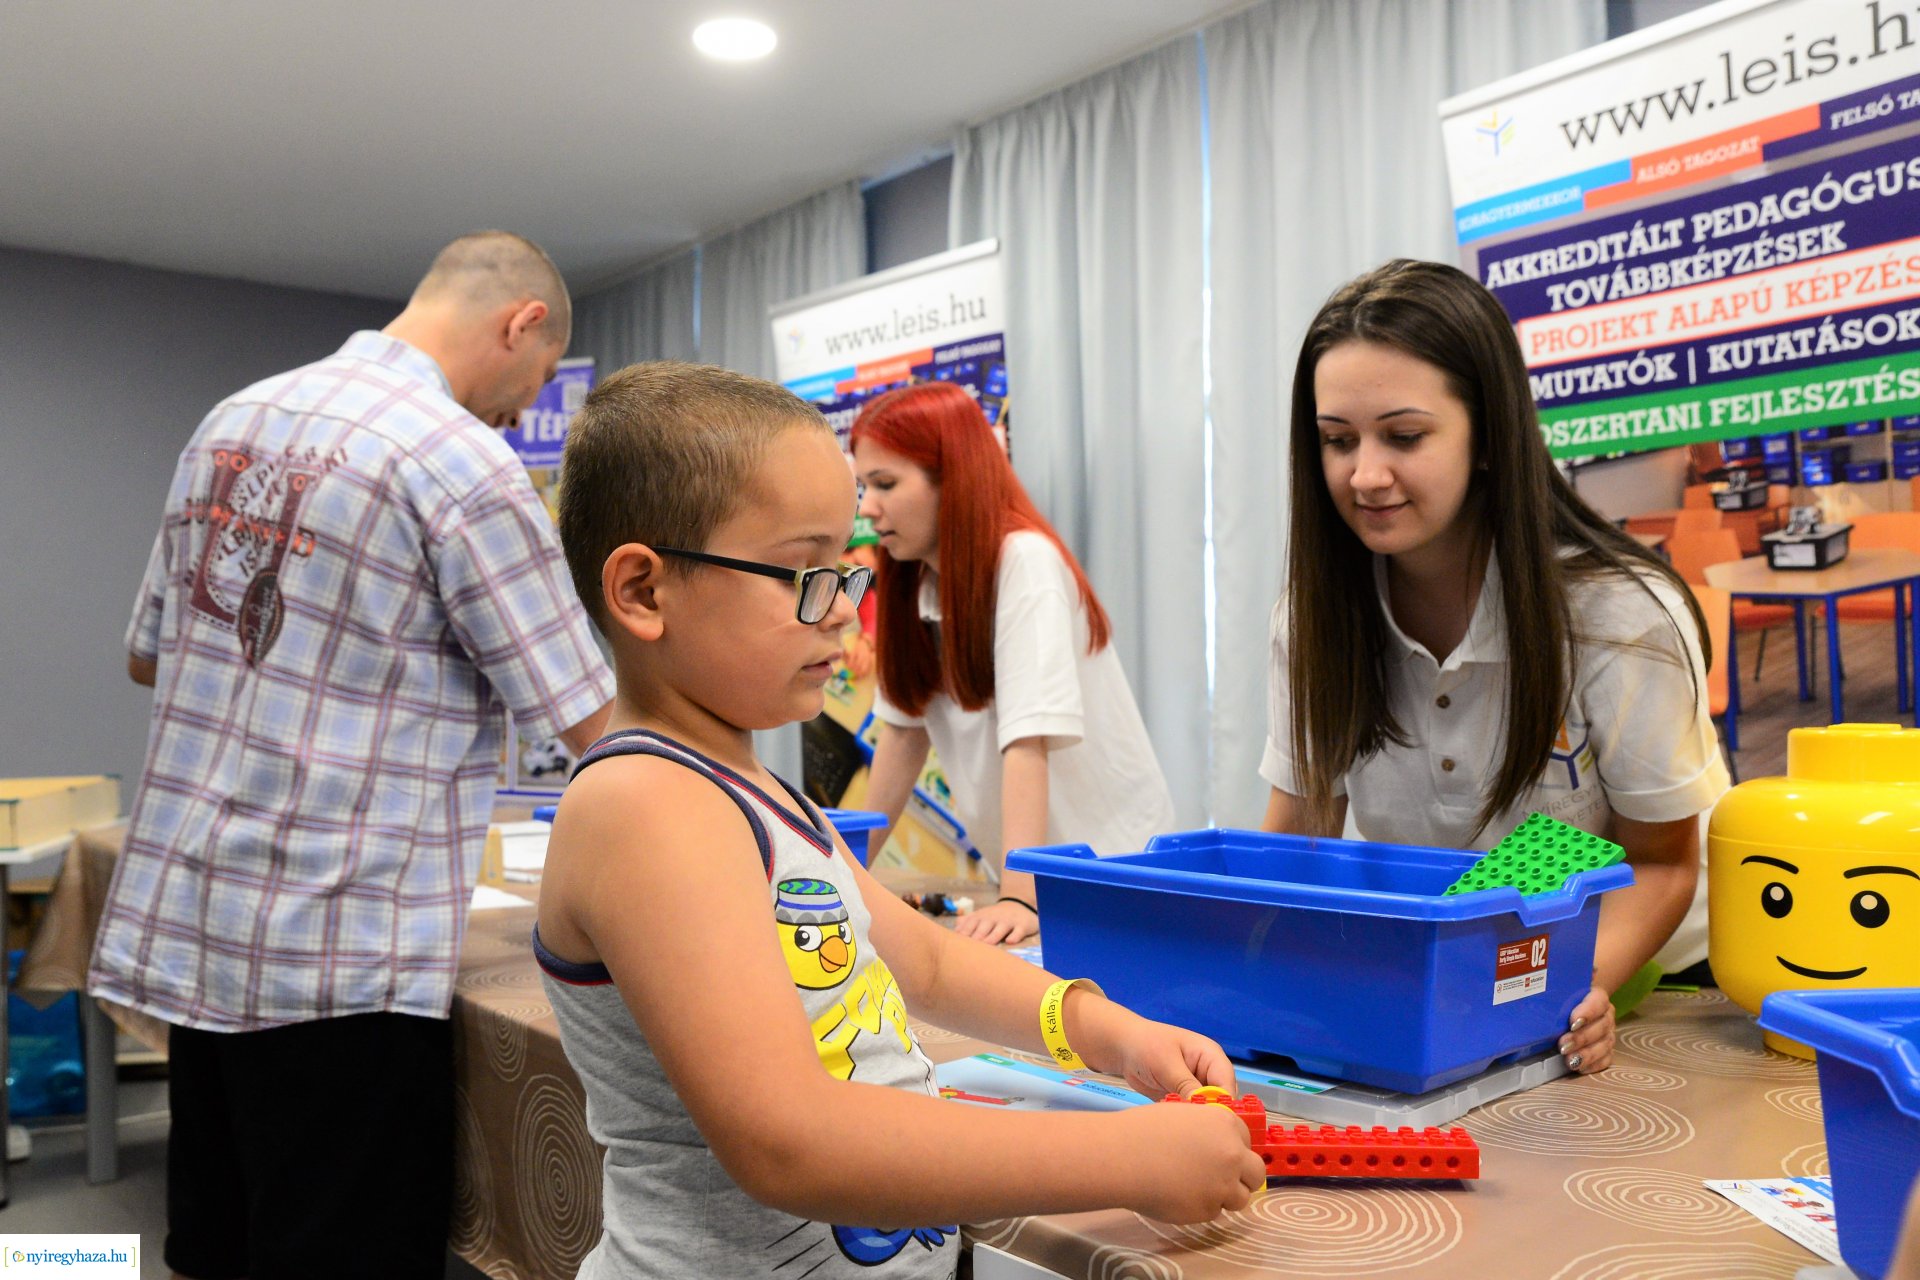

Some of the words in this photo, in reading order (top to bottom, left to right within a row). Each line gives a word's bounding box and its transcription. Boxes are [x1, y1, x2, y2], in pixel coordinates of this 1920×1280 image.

[1560, 1, 1920, 149] www.leis.h
[1636, 157, 1681, 184] ALSÓ
[1682, 136, 1760, 171] TAGOZAT
[1485, 219, 1685, 290] AKKREDITÁLT
[1691, 157, 1920, 243] PEDAGÓGUS
[1546, 220, 1847, 312] TOVÁBBKÉPZÉSEK
[825, 293, 987, 355] www.leis.hu
[1531, 310, 1657, 356] PROJEKT
[1669, 280, 1773, 331] ALAPÚ
[1785, 250, 1920, 309] KÉPZÉS
[1707, 314, 1920, 374] KUTATÁSOK
[1708, 363, 1920, 427] FEJLESZTÉS
[1531, 938, 1547, 968] 02
[1047, 998, 1060, 1034] Kállay
